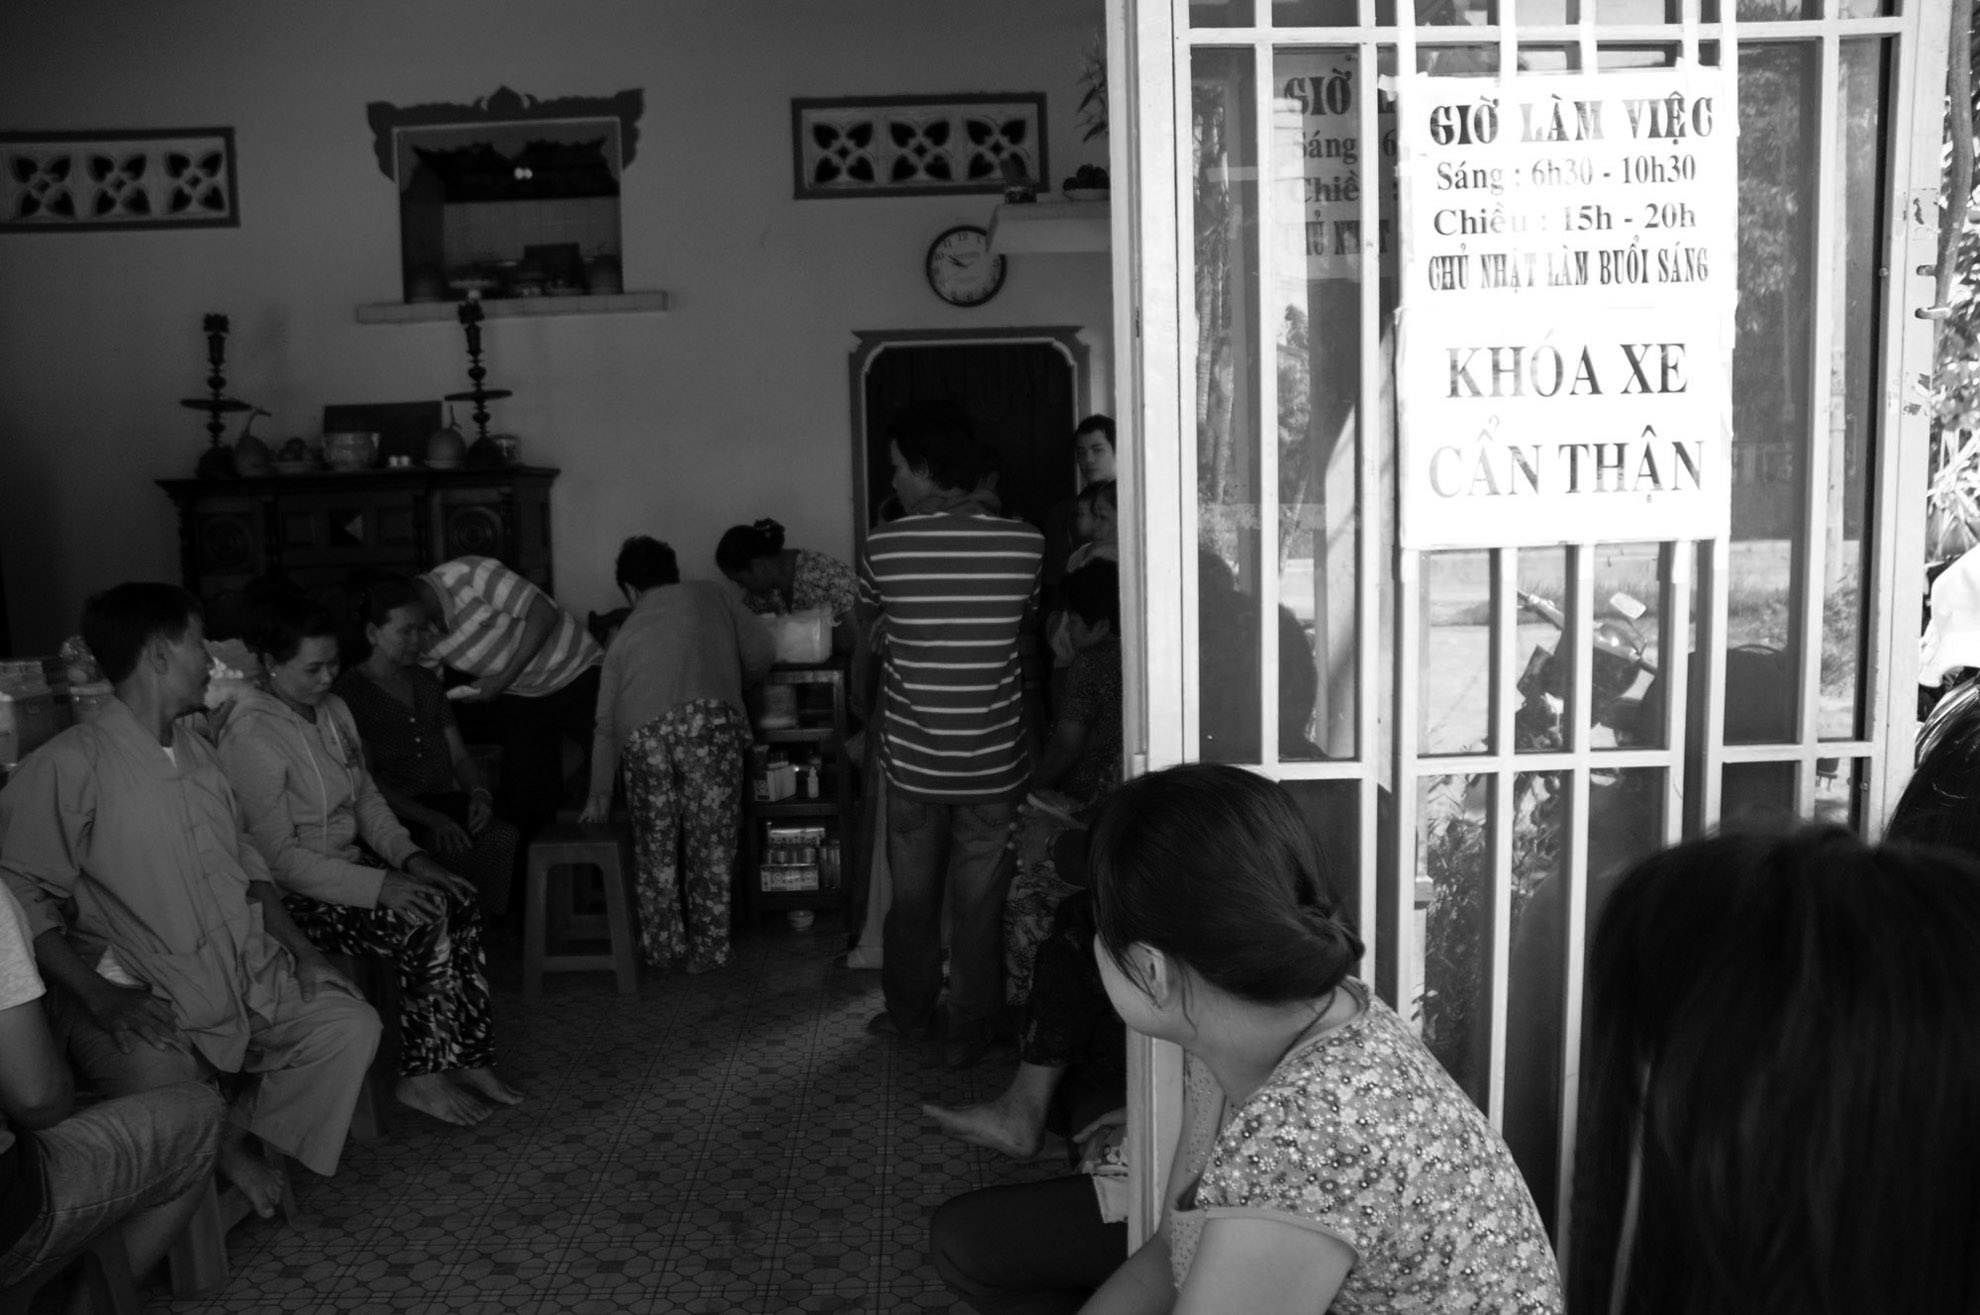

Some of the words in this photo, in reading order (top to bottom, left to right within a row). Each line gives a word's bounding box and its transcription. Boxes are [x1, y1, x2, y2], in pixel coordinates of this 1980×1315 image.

[1429, 95, 1500, 146] GIỜ
[1519, 93, 1605, 143] LÀM
[1622, 90, 1713, 146] VIỆC
[1303, 130, 1357, 165] áng
[1436, 160, 1504, 196] Sáng
[1531, 157, 1594, 186] 6h30
[1621, 154, 1697, 184] 10h30
[1433, 202, 1527, 236] Chiều
[1563, 204, 1614, 232] 15h
[1643, 202, 1697, 229] 20h
[1428, 242, 1470, 291] CHỦ
[1548, 244, 1590, 287] LÀM
[1598, 234, 1649, 285] BUỔI
[1657, 241, 1710, 283] SÁNG
[1446, 328, 1604, 398] KHÓA
[1619, 343, 1689, 394] XE
[1428, 414, 1544, 499] CẨN
[1557, 424, 1705, 504] THẬN
